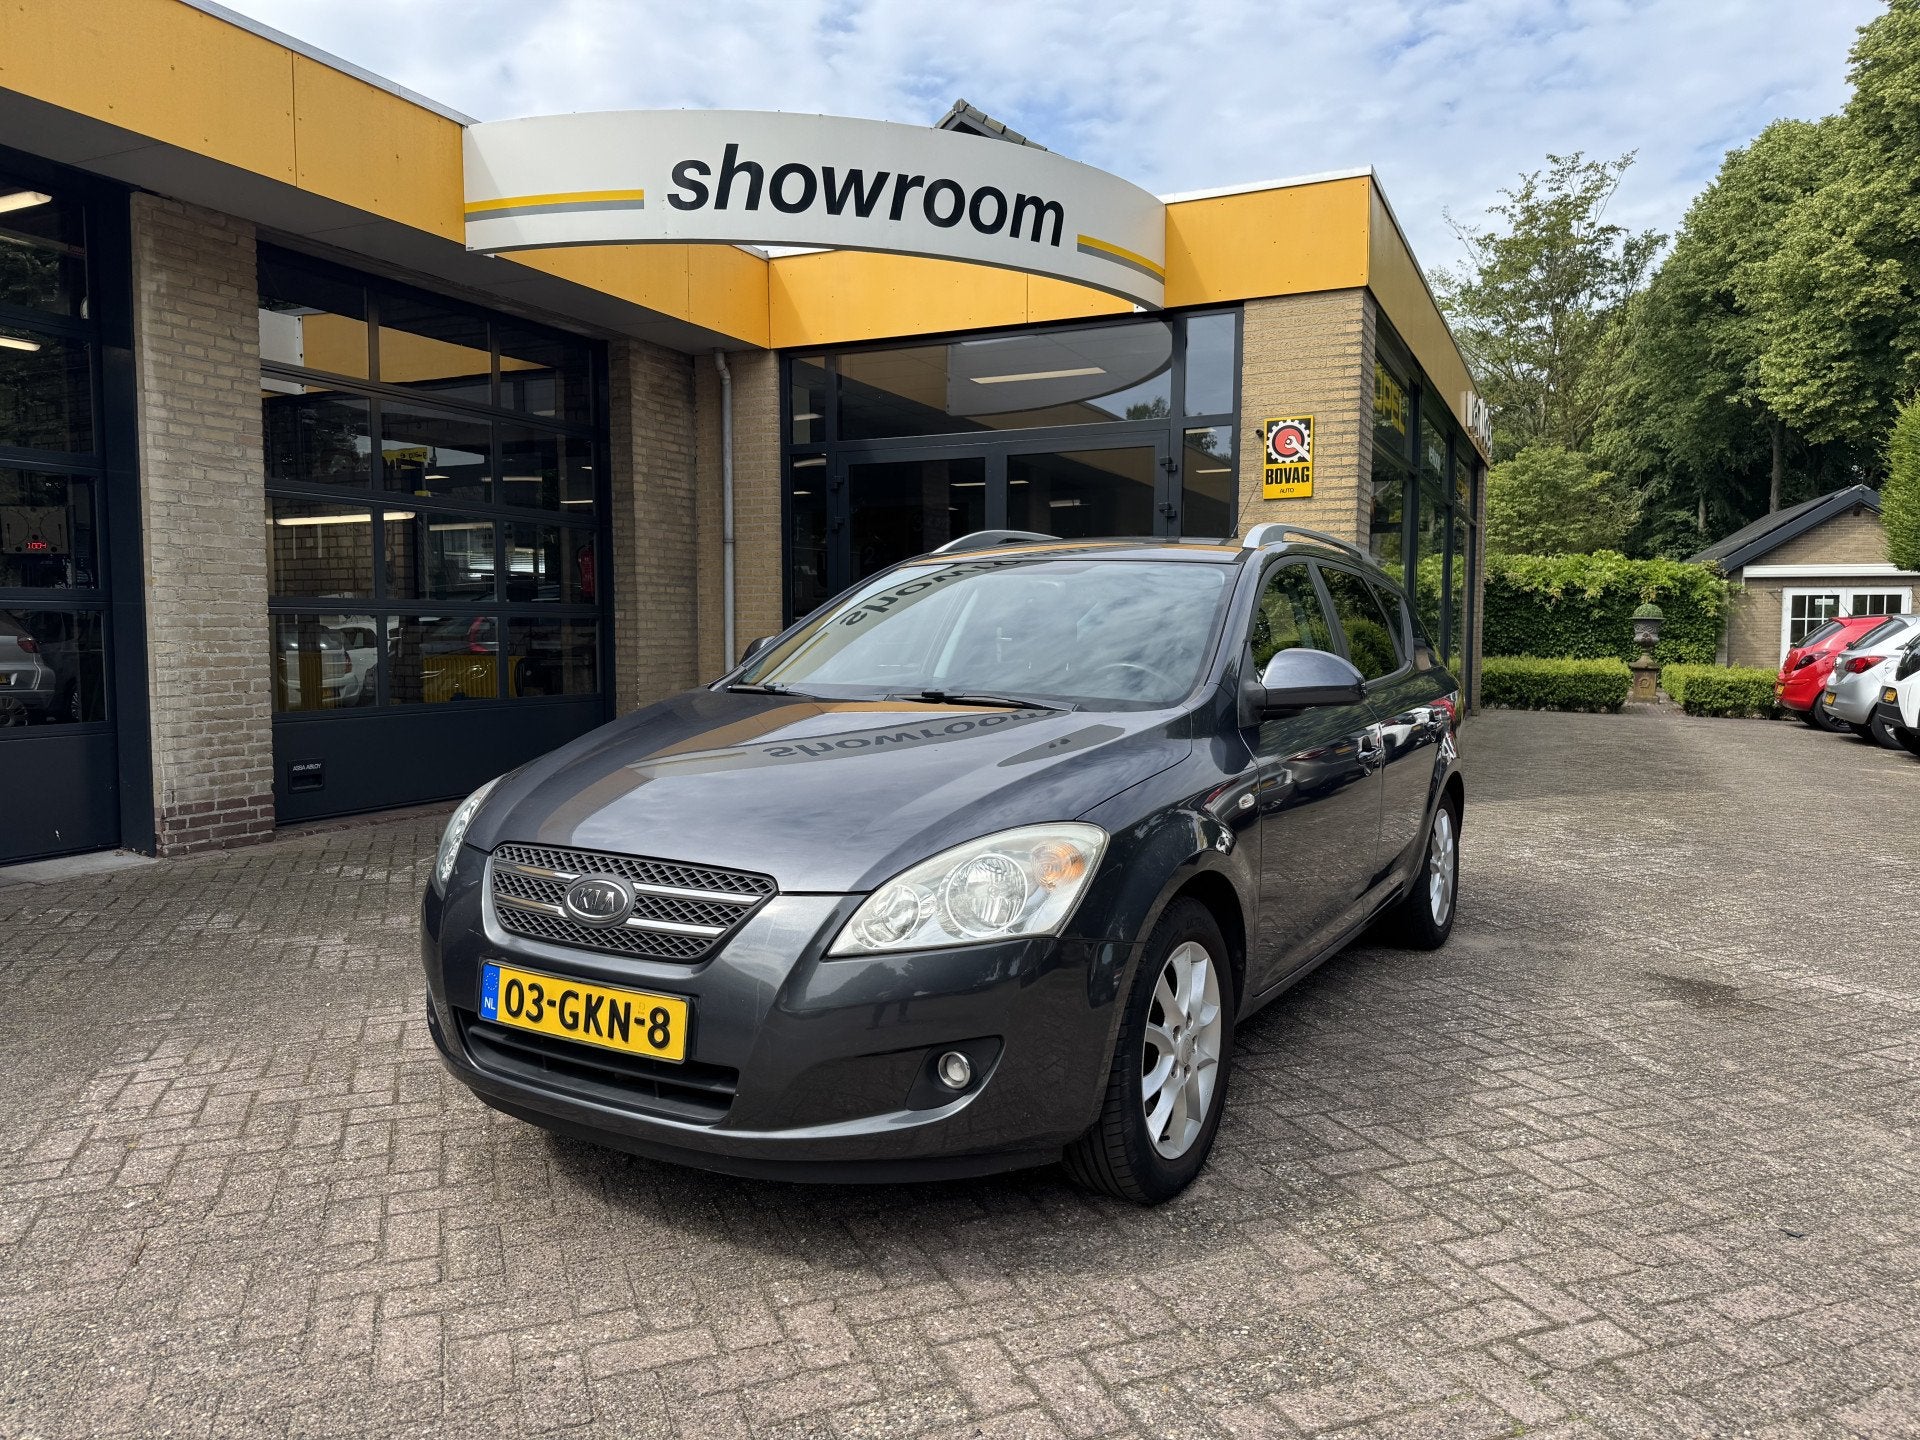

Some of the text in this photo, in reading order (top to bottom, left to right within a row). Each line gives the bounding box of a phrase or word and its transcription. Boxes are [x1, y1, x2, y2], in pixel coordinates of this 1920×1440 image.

[667, 143, 1064, 247] showroom
[1266, 467, 1310, 485] BOVAG
[575, 888, 614, 911] KIA
[484, 997, 496, 1010] NL
[505, 978, 671, 1049] 03-GKN-8
